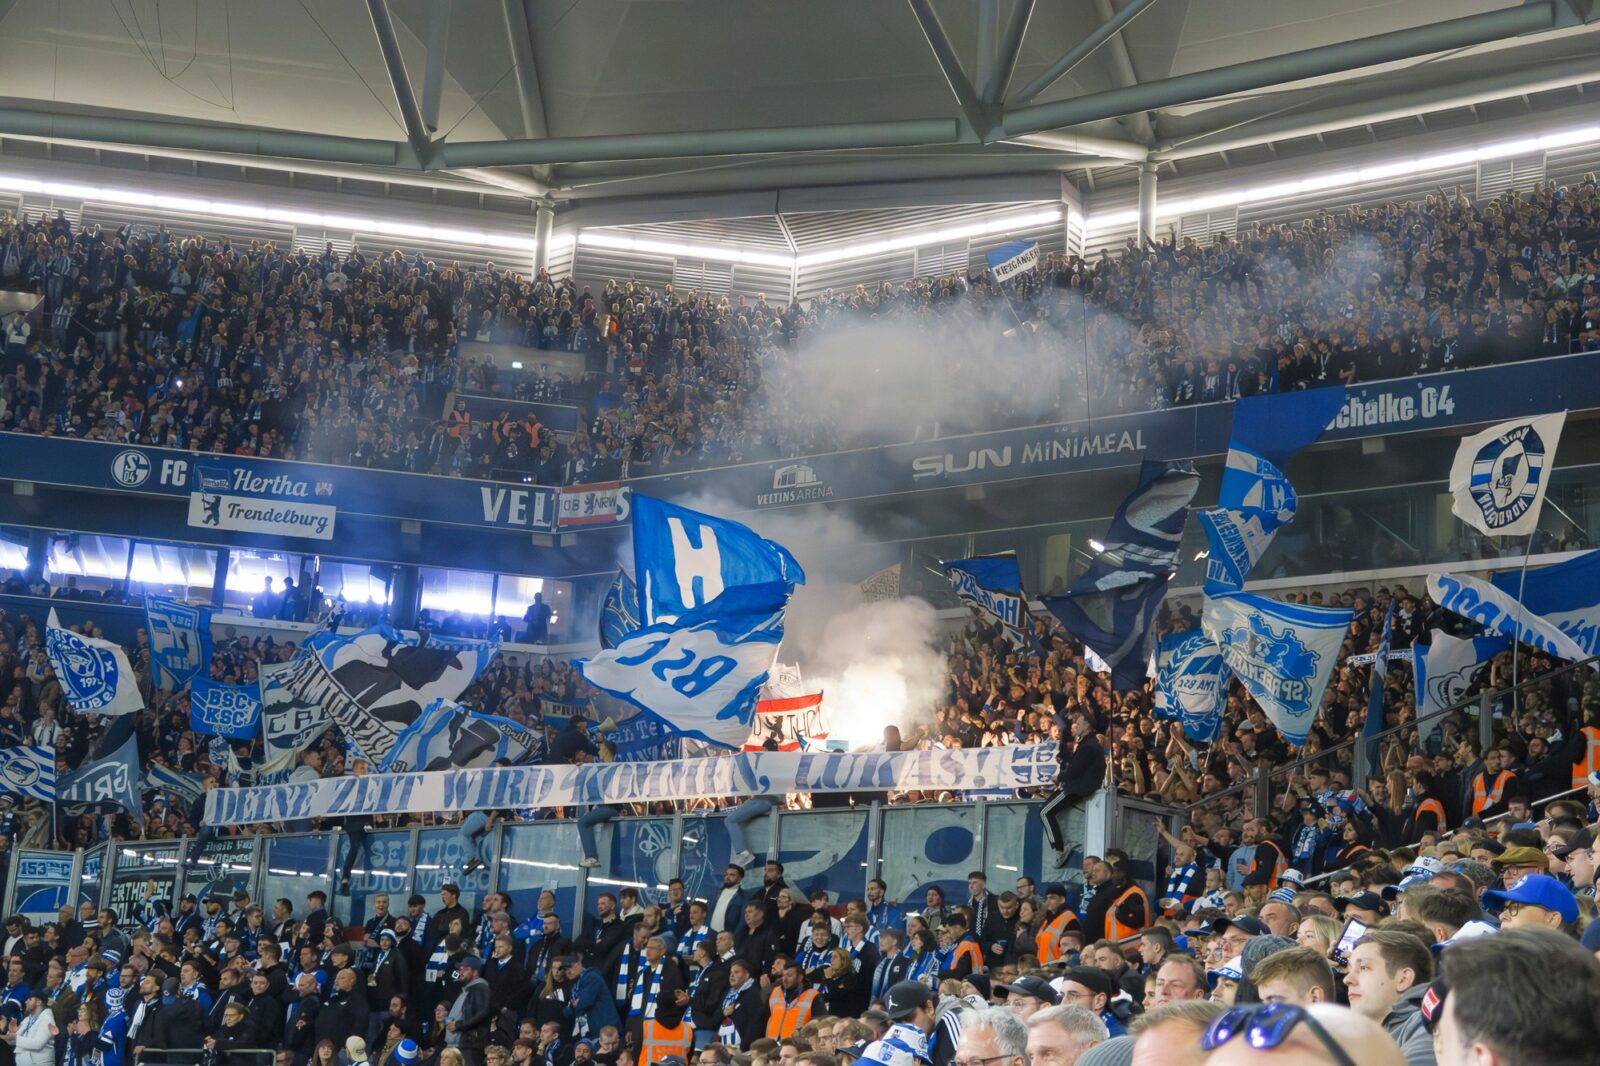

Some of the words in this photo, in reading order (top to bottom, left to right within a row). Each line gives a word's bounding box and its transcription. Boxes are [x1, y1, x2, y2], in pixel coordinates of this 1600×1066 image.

[1421, 385, 1455, 418] 04
[160, 459, 188, 486] FC
[912, 446, 1012, 481] SUN
[233, 468, 309, 497] Hertha
[227, 502, 329, 534] Trendelburg
[207, 688, 249, 710] BSC
[203, 707, 246, 728] KSC
[212, 781, 320, 825] DEINE
[327, 774, 425, 814] ZEIT
[442, 766, 554, 812] WIRD
[794, 746, 992, 793] LUKAS!
